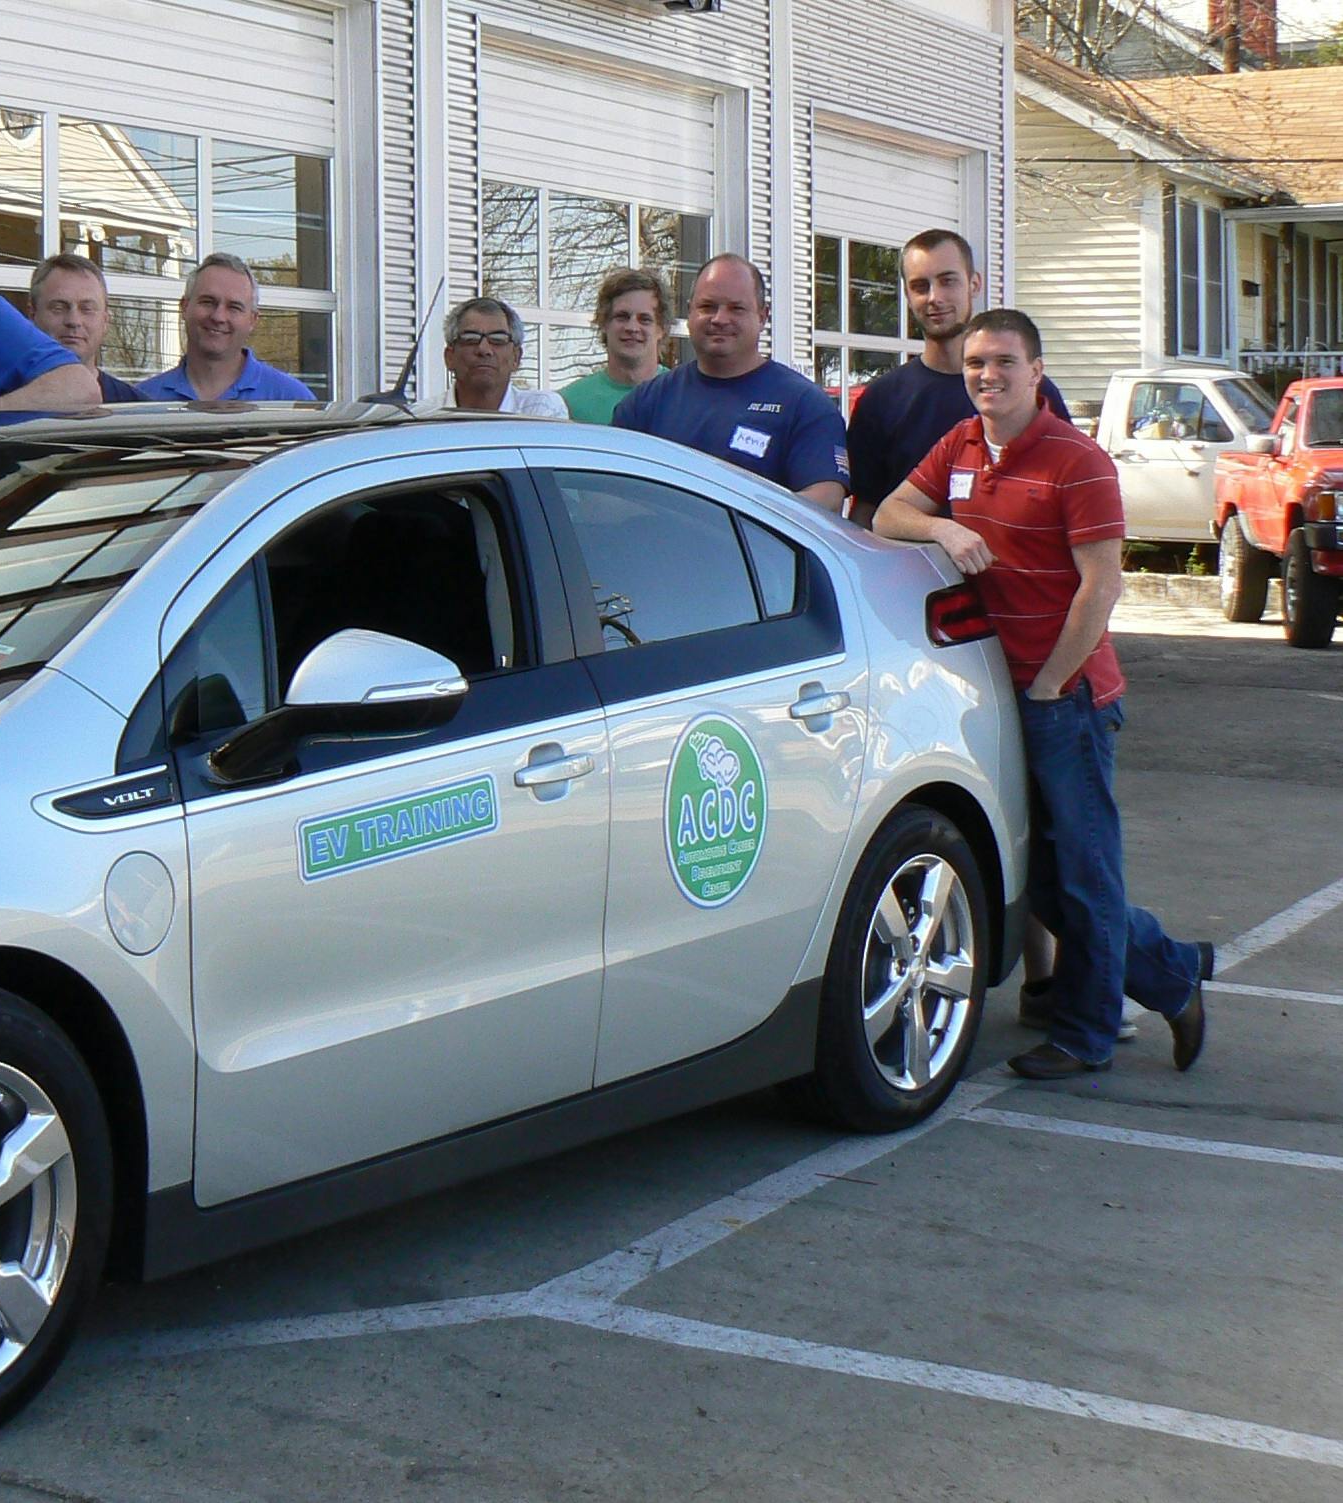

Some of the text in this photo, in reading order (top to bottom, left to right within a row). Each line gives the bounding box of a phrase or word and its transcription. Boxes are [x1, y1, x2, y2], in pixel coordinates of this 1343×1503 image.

[103, 787, 155, 806] VOLT
[309, 788, 490, 865] EV TRAINING
[677, 780, 757, 847] ACDC
